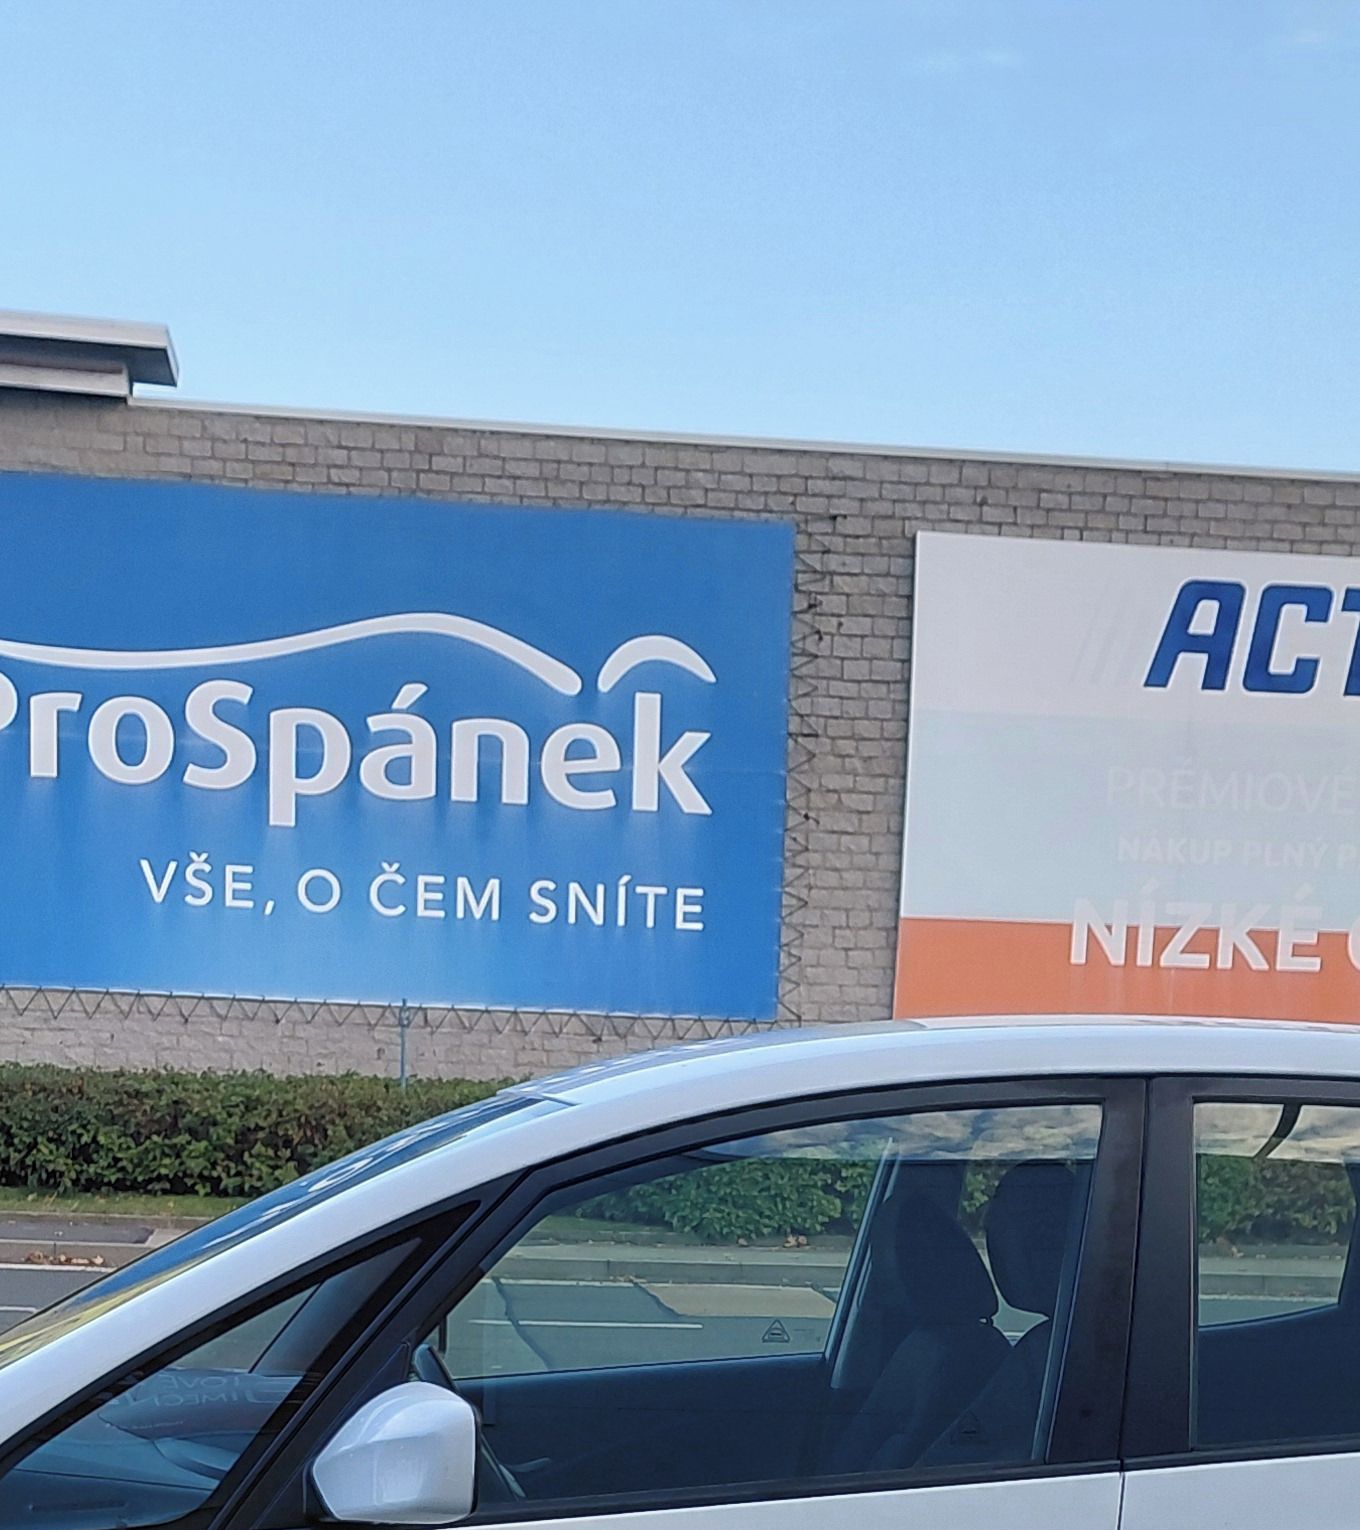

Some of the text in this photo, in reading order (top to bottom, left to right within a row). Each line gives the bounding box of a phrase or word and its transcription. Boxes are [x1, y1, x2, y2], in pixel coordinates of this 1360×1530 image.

[1117, 826, 1233, 867] NÁKUP
[1245, 836, 1329, 869] PLNÝ
[140, 851, 706, 932] VŠE, O ČEM SNÍTE
[1068, 877, 1324, 973] NÍZKÉ
